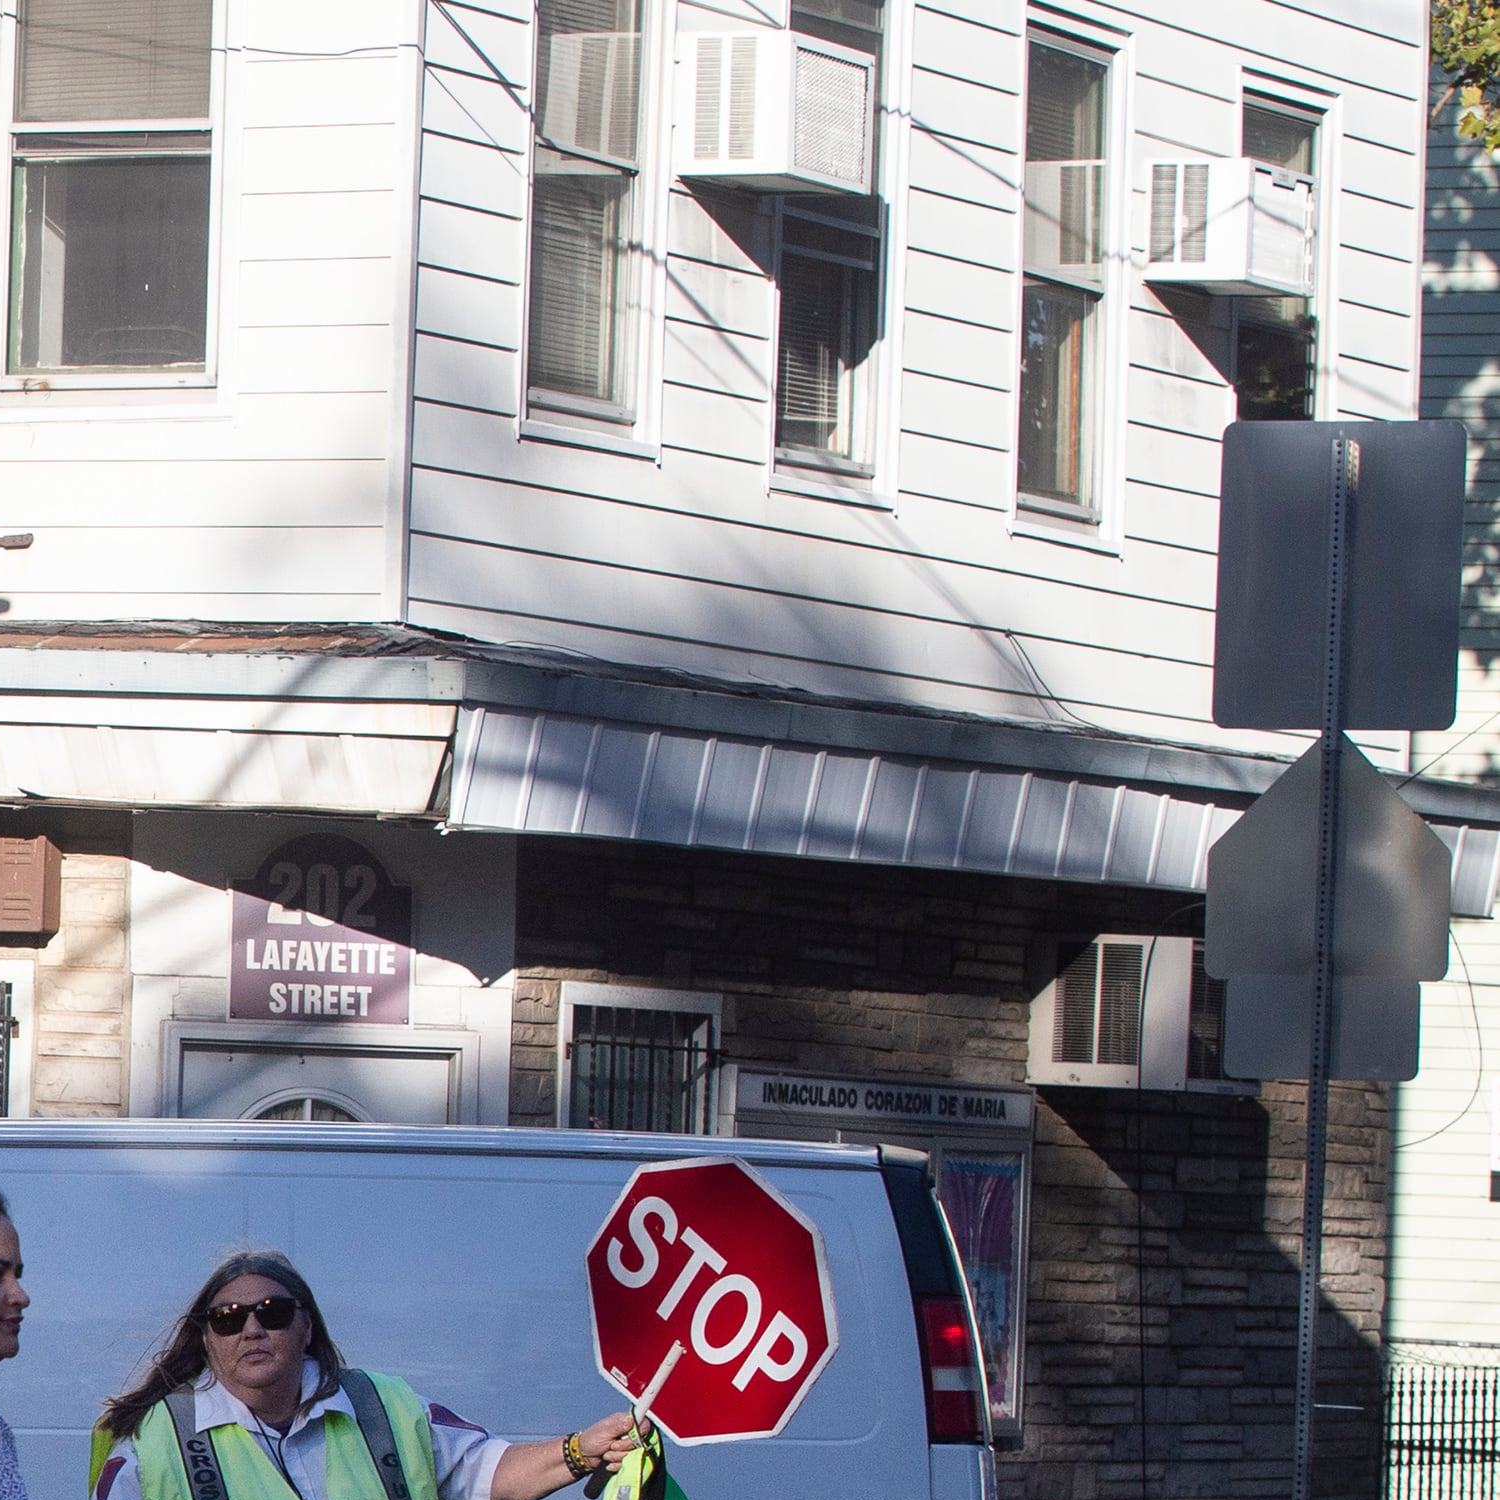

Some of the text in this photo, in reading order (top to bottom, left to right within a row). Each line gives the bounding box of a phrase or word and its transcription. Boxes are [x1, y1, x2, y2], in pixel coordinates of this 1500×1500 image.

[266, 861, 378, 928] 202
[245, 939, 397, 975] LAFAYETTE
[268, 982, 373, 1017] STREET
[762, 1081, 1007, 1120] INMACULADO CORAZON DE MARIA
[606, 1195, 809, 1393] STOP
